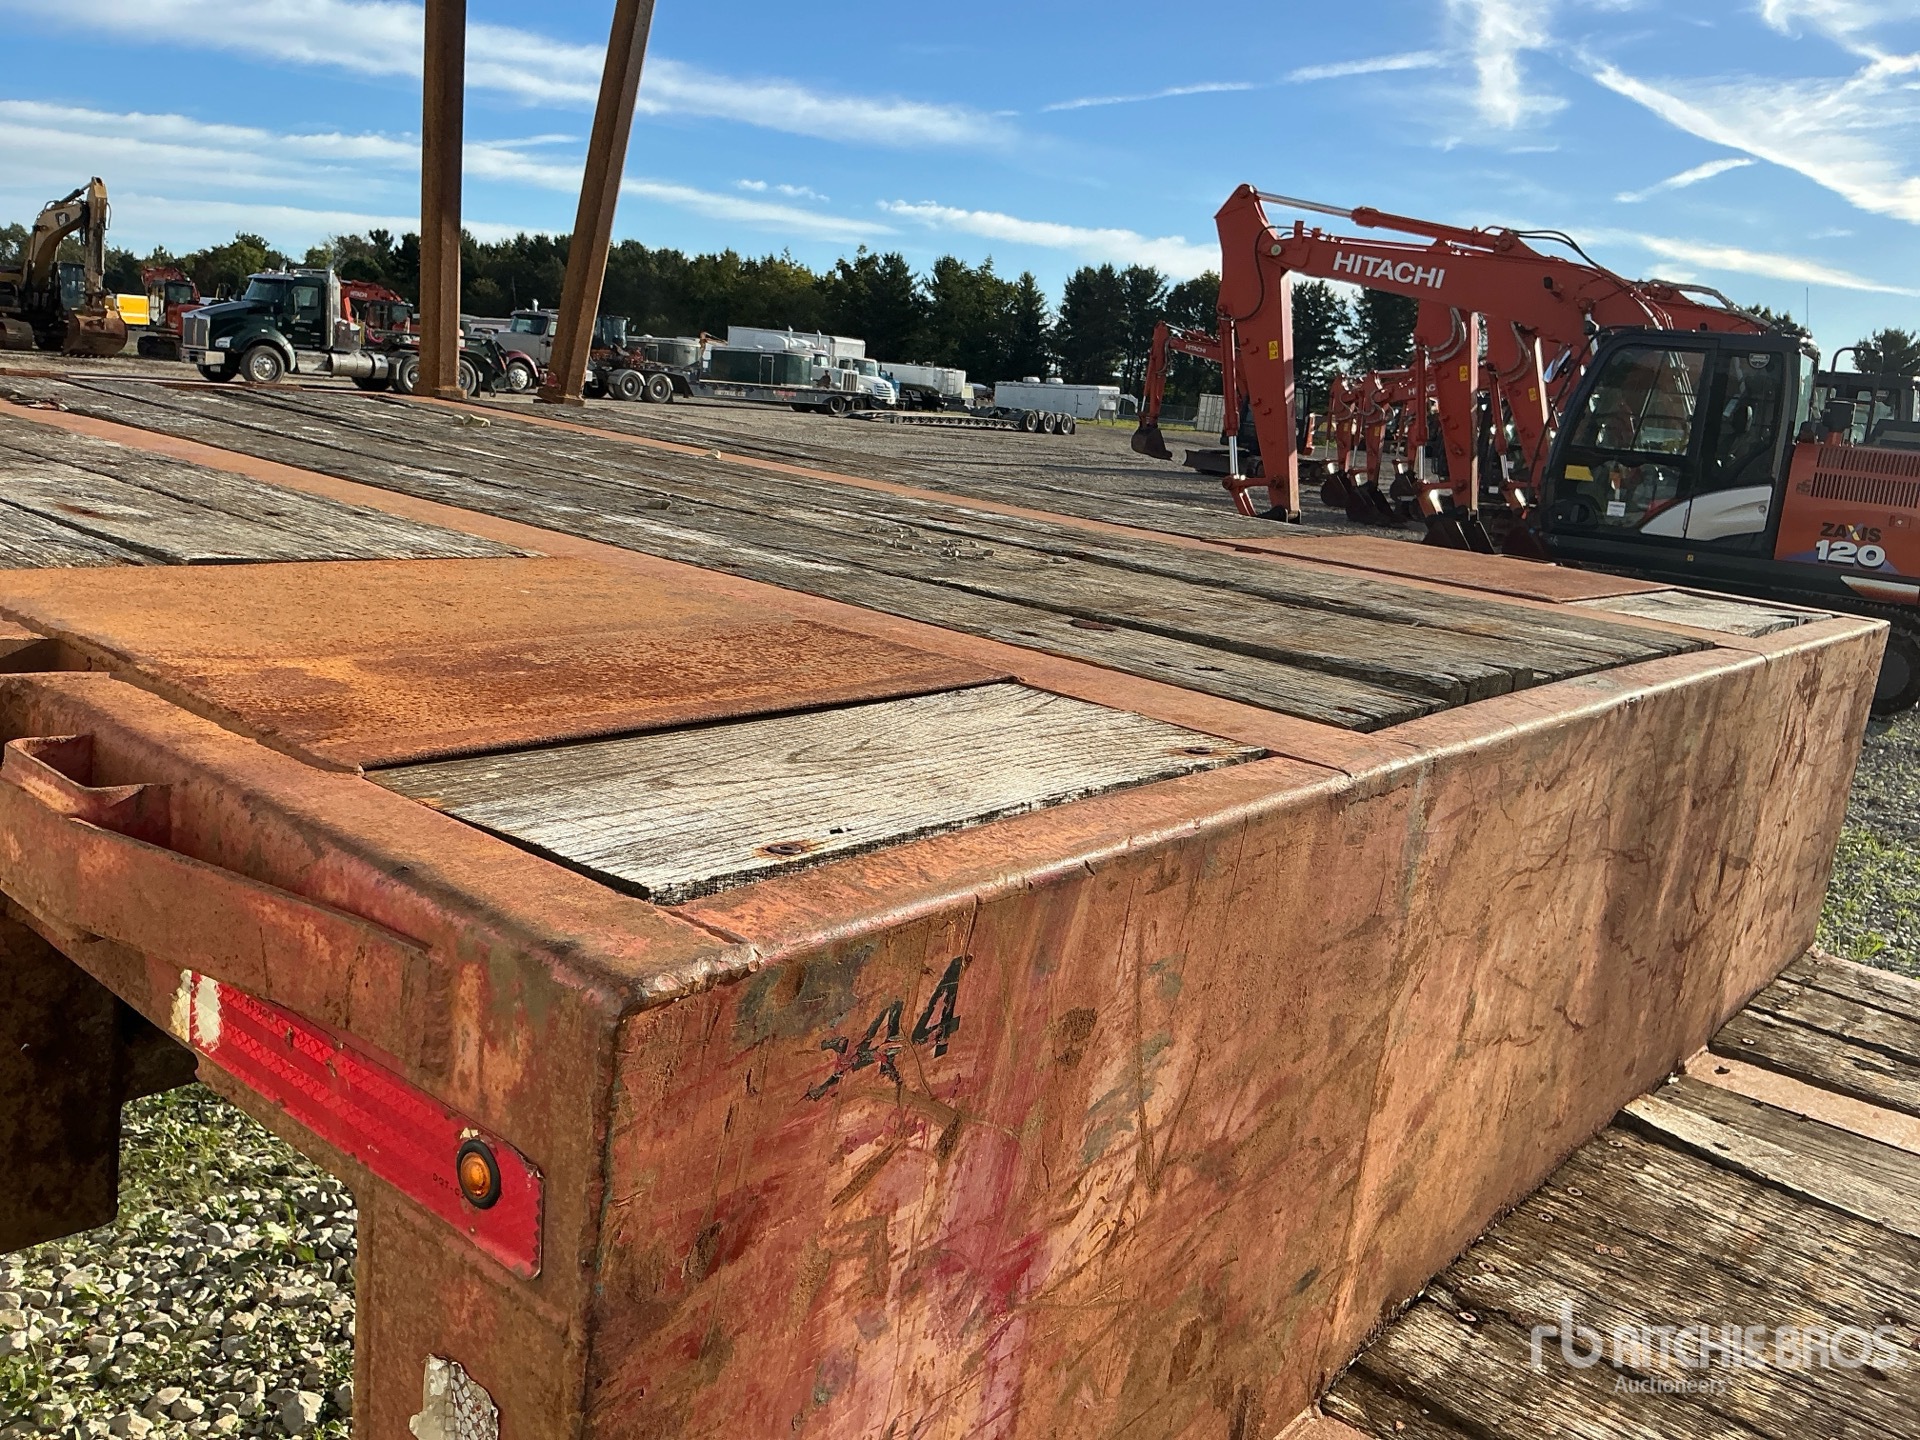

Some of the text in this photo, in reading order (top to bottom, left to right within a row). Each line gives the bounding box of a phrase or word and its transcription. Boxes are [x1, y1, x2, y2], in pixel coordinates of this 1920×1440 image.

[1332, 251, 1446, 290] HITACHI
[1184, 344, 1207, 354] HITACHI
[1820, 521, 1882, 542] ZAXIS
[1815, 539, 1886, 570] 120
